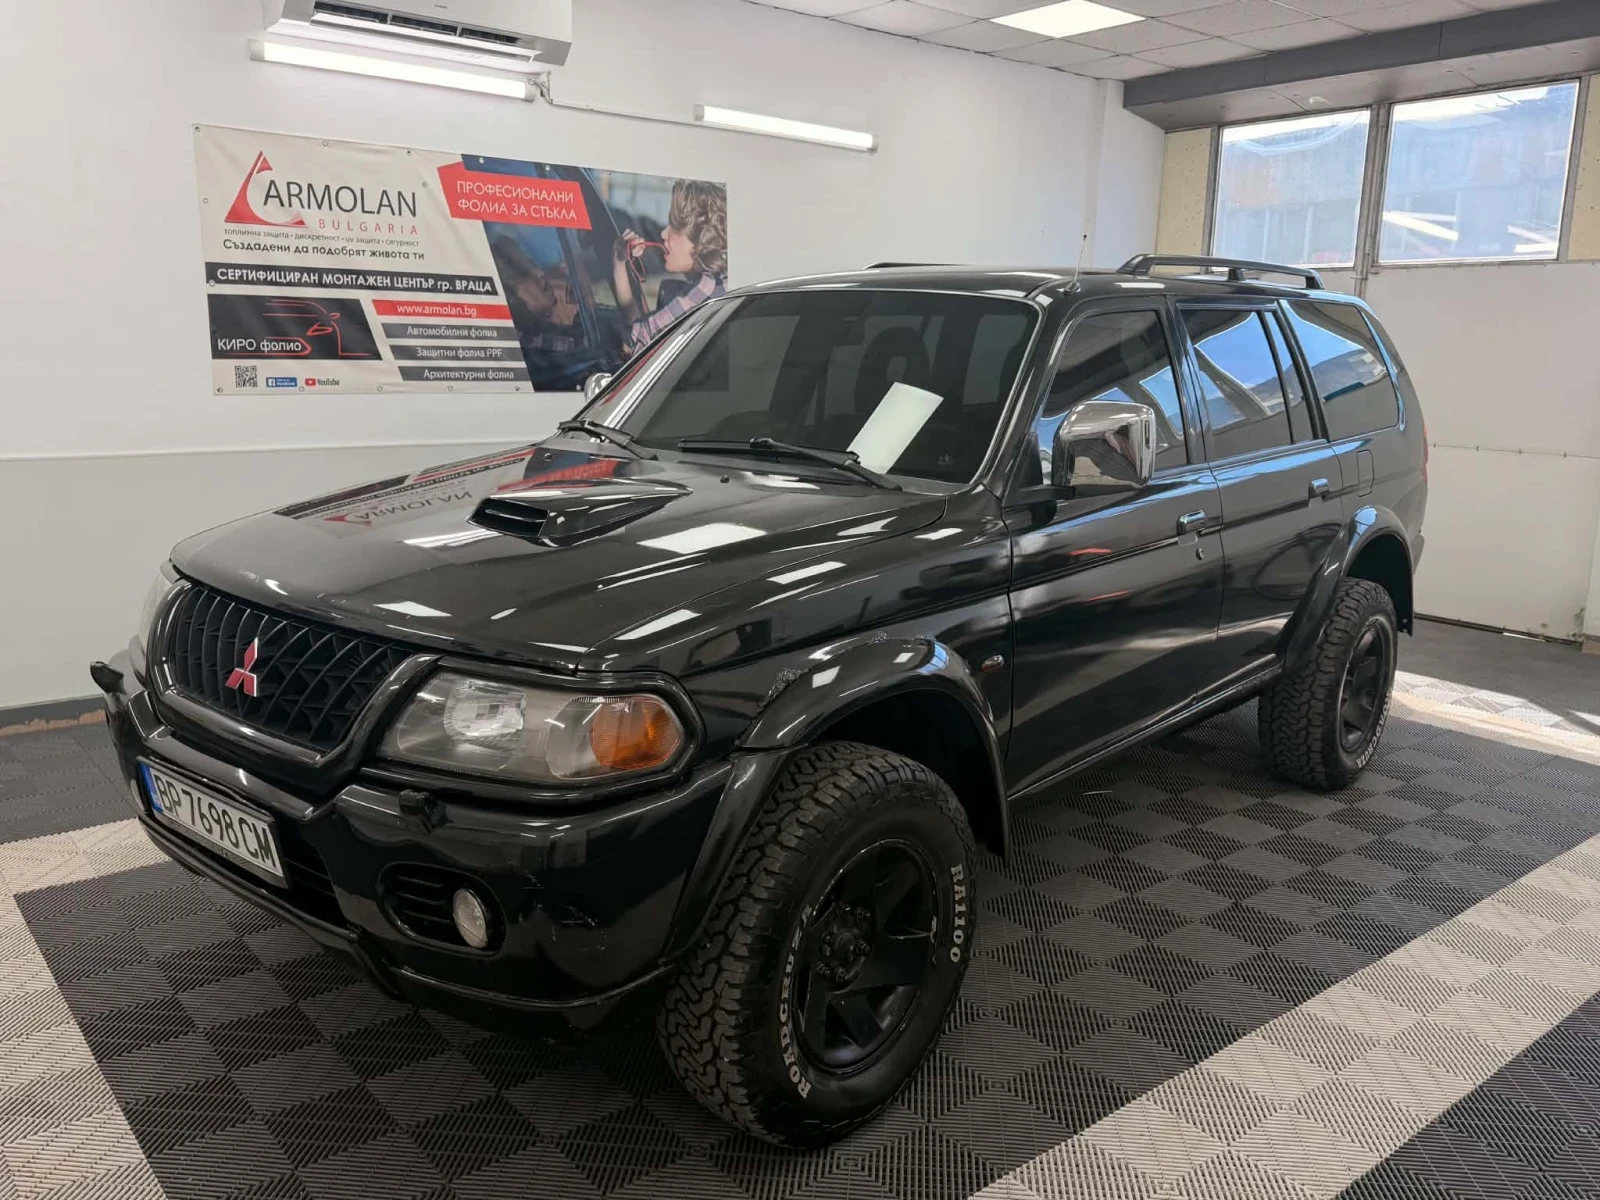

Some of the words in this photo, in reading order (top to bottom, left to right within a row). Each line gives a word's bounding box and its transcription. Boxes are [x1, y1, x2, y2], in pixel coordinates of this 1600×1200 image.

[263, 179, 417, 217] ARMOLAN
[457, 180, 574, 204] ПРОФЕСИОНАЛНИ
[458, 199, 508, 215] ФОЛИА
[511, 203, 528, 216] ЗА
[530, 205, 577, 220] СТЪКЛА
[318, 218, 419, 236] BULGARIA
[223, 239, 291, 252] Създадени
[293, 245, 309, 254] да
[312, 246, 366, 258] подобрят
[369, 249, 410, 260] живота
[412, 252, 424, 260] ти
[217, 268, 319, 285] СЕРТИФИЦИРАН
[322, 273, 391, 287] МОНТАЖЕН
[394, 276, 435, 290] ЦЕНТЪР
[437, 281, 453, 291] гр.
[455, 280, 492, 292] ВРАЦА
[396, 304, 477, 318] www.armolan.bg
[406, 325, 469, 337] Автомобилни
[470, 327, 498, 338] фолиа
[217, 338, 257, 351] КИРО
[260, 338, 302, 354] фолио
[416, 347, 456, 358] Защитни
[457, 348, 485, 359] фолиа
[423, 368, 487, 381] Архитектурни
[487, 369, 515, 380] фолиа
[950, 863, 966, 963] RA1100
